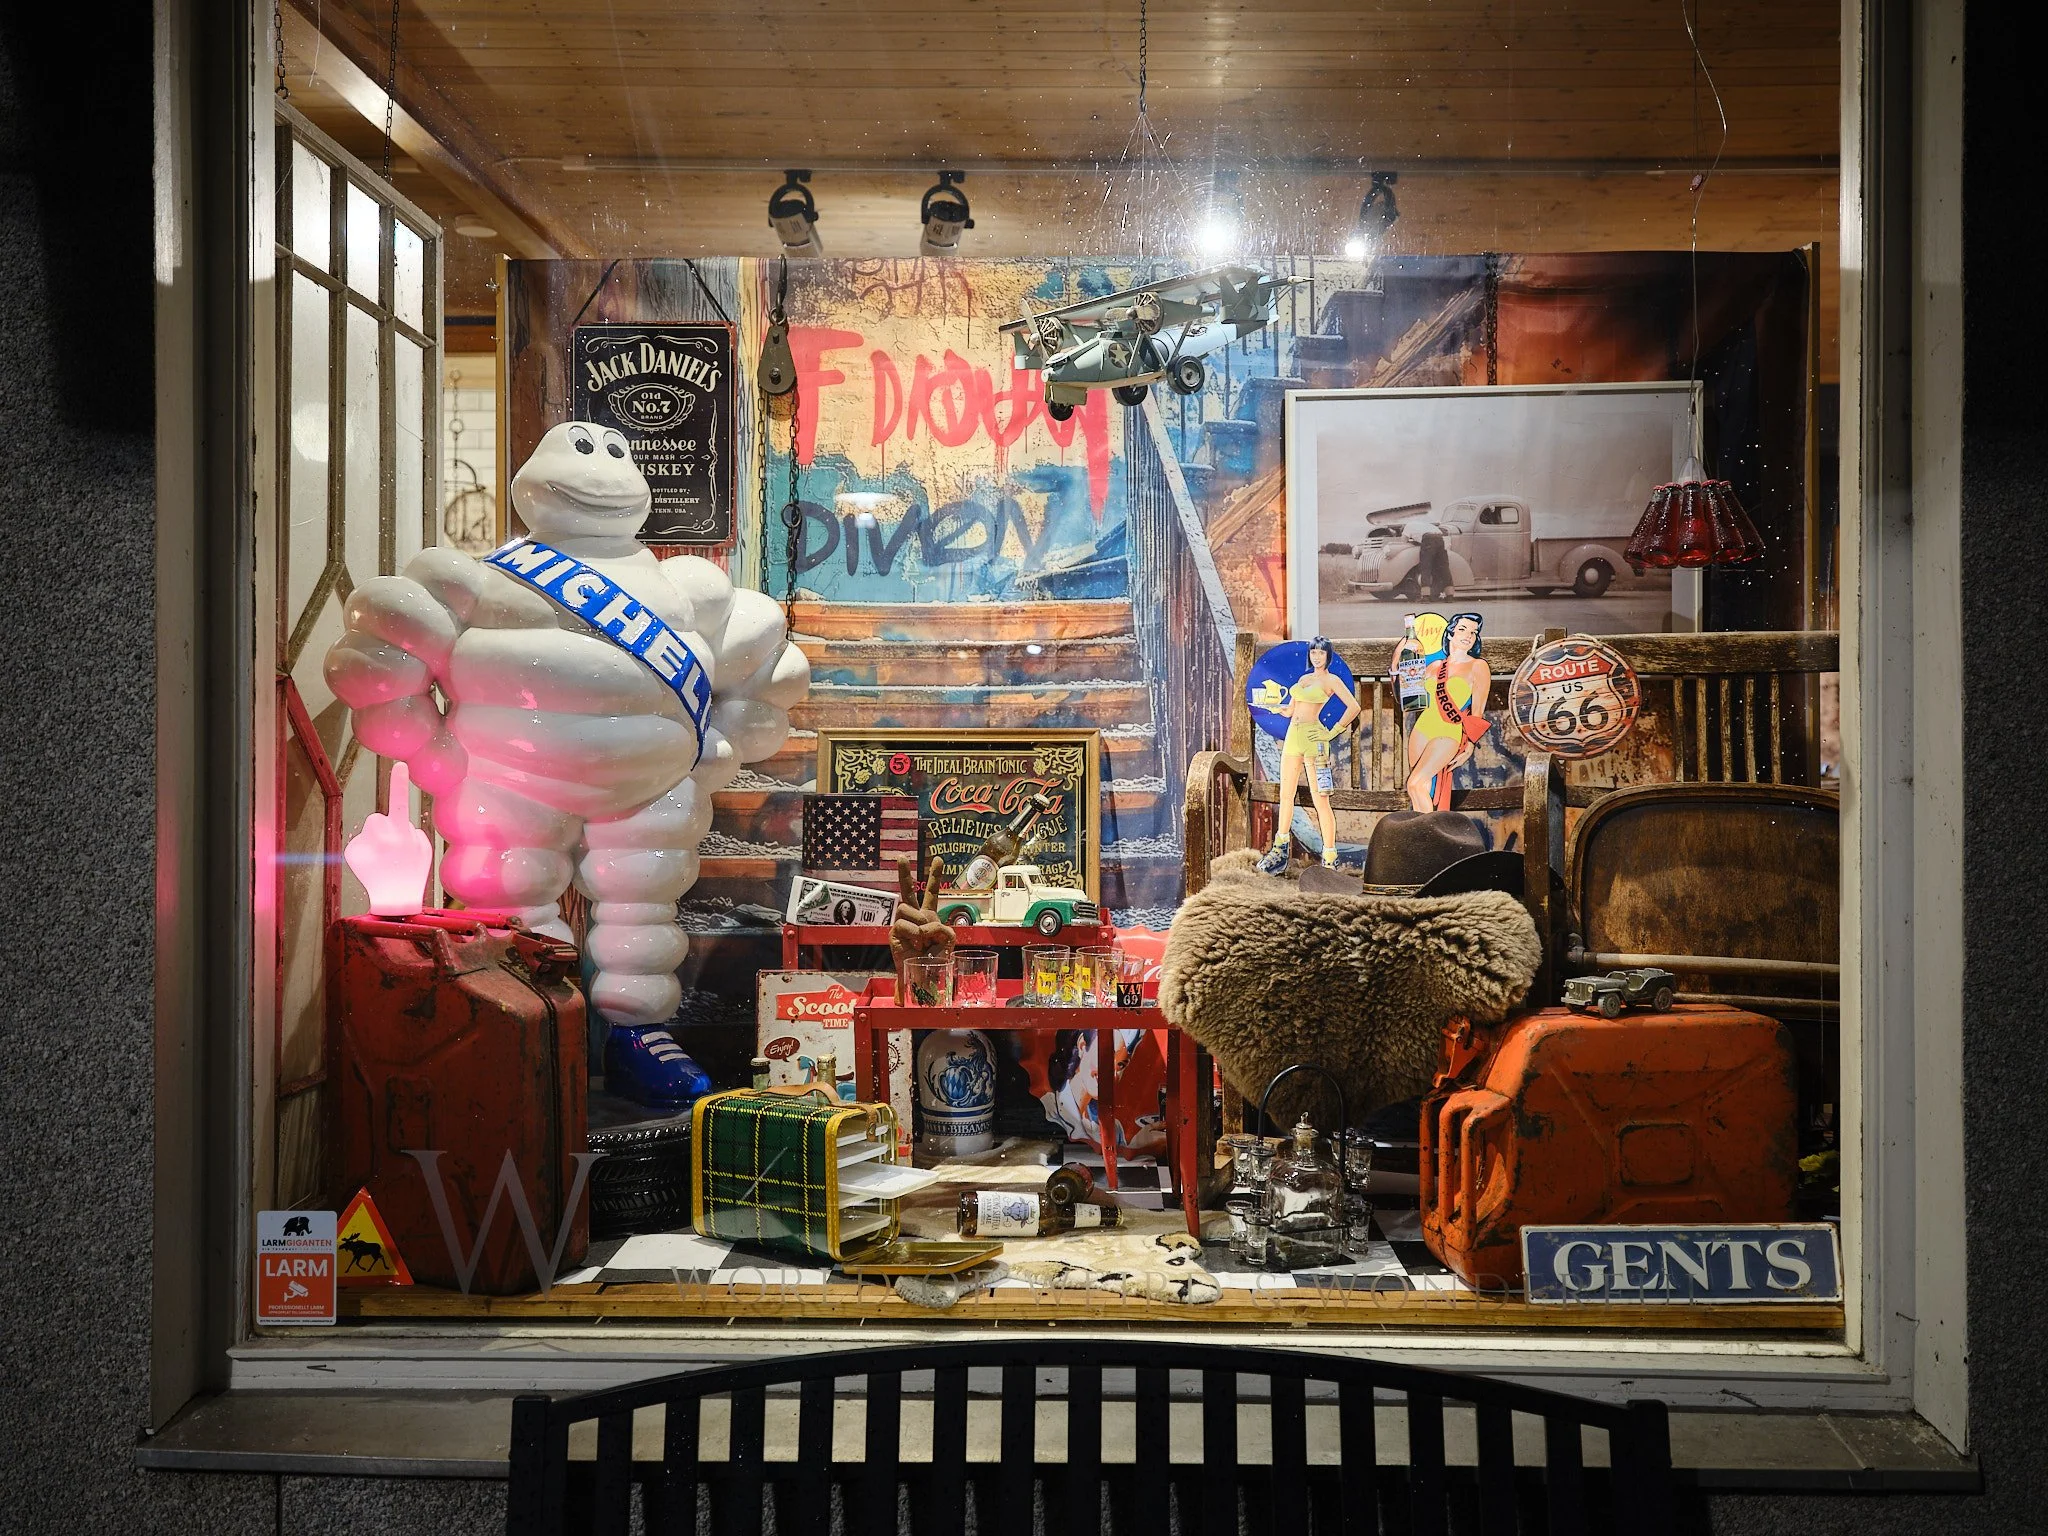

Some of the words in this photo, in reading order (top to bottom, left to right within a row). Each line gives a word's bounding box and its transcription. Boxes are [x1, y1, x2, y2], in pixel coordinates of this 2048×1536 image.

[585, 351, 639, 392] JACK
[640, 342, 722, 393] DANIEL'S
[640, 391, 661, 400] Old
[629, 438, 697, 452] nnessee
[636, 463, 696, 476] ISKEY
[1540, 659, 1600, 680] ROUTE
[1562, 682, 1584, 694] US
[1436, 681, 1462, 724] BERGER
[1547, 691, 1609, 736] 66
[933, 757, 963, 775] IDEAL
[963, 757, 995, 775] BRAIN
[995, 757, 1028, 774] TONIC
[929, 842, 981, 856] DELIGHTF
[828, 987, 843, 999] The
[1118, 984, 1142, 995] VAT
[787, 996, 857, 1017] Scoot
[823, 1018, 849, 1028] TIME
[401, 1149, 610, 1302] W
[262, 1239, 332, 1247] LARMGIGANTEN
[265, 1259, 328, 1277] LARM
[1553, 1240, 1813, 1293] GENTS
